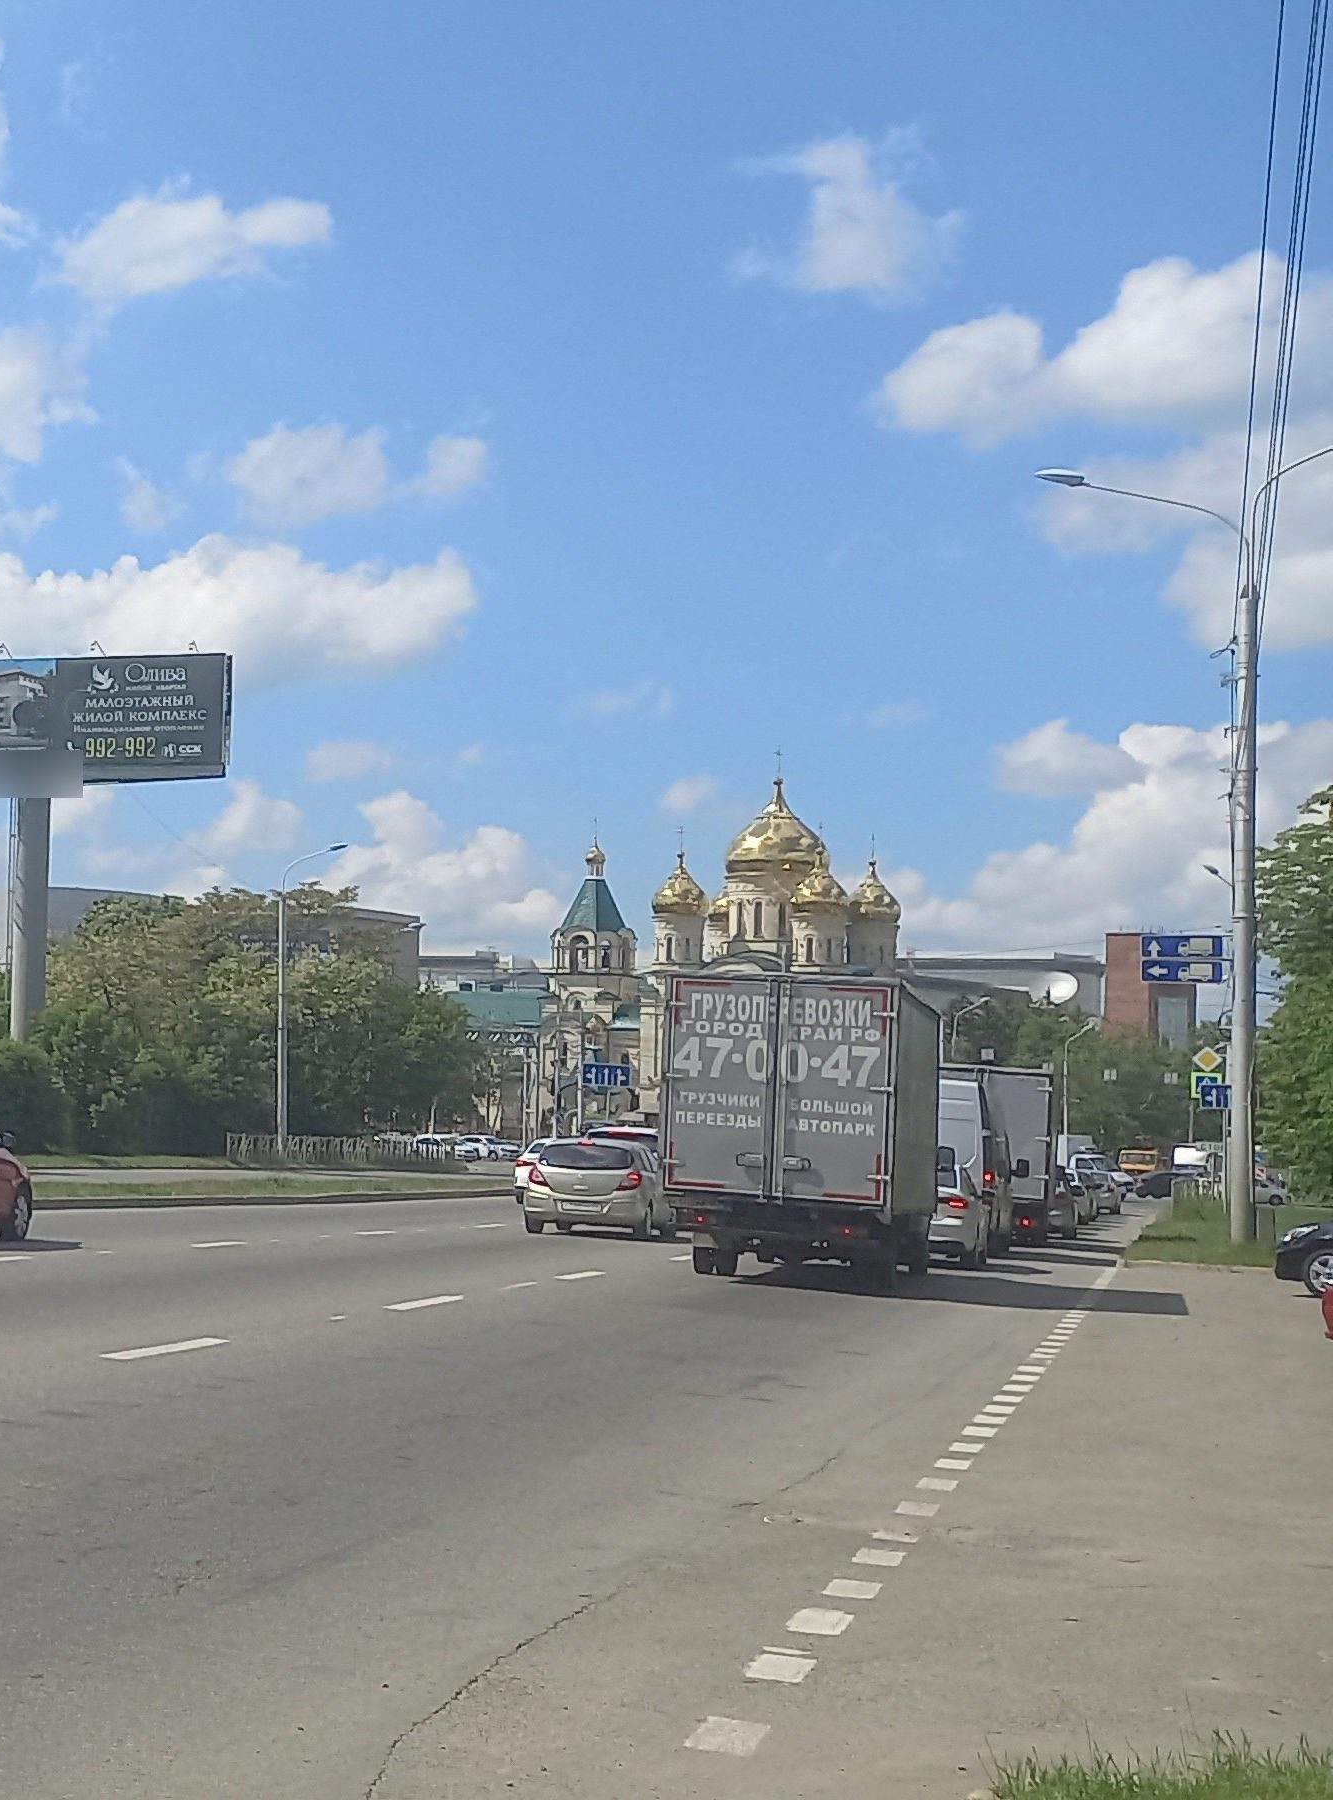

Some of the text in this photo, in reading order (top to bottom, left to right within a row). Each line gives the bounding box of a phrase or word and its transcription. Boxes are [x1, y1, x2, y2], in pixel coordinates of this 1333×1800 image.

[125, 663, 187, 682] Олива
[84, 694, 195, 709] МАЛОЭТАЖНЫЙ
[72, 709, 208, 723] ЖИЛОЙ КОМПЛЕКС
[85, 736, 156, 758] 992-992
[681, 1019, 763, 1040] ГОРОД
[850, 1027, 881, 1042] РФ
[679, 1091, 760, 1108] ГРУЗЧИКИ
[675, 1111, 762, 1129] ПЕРЕЕЗДЫ
